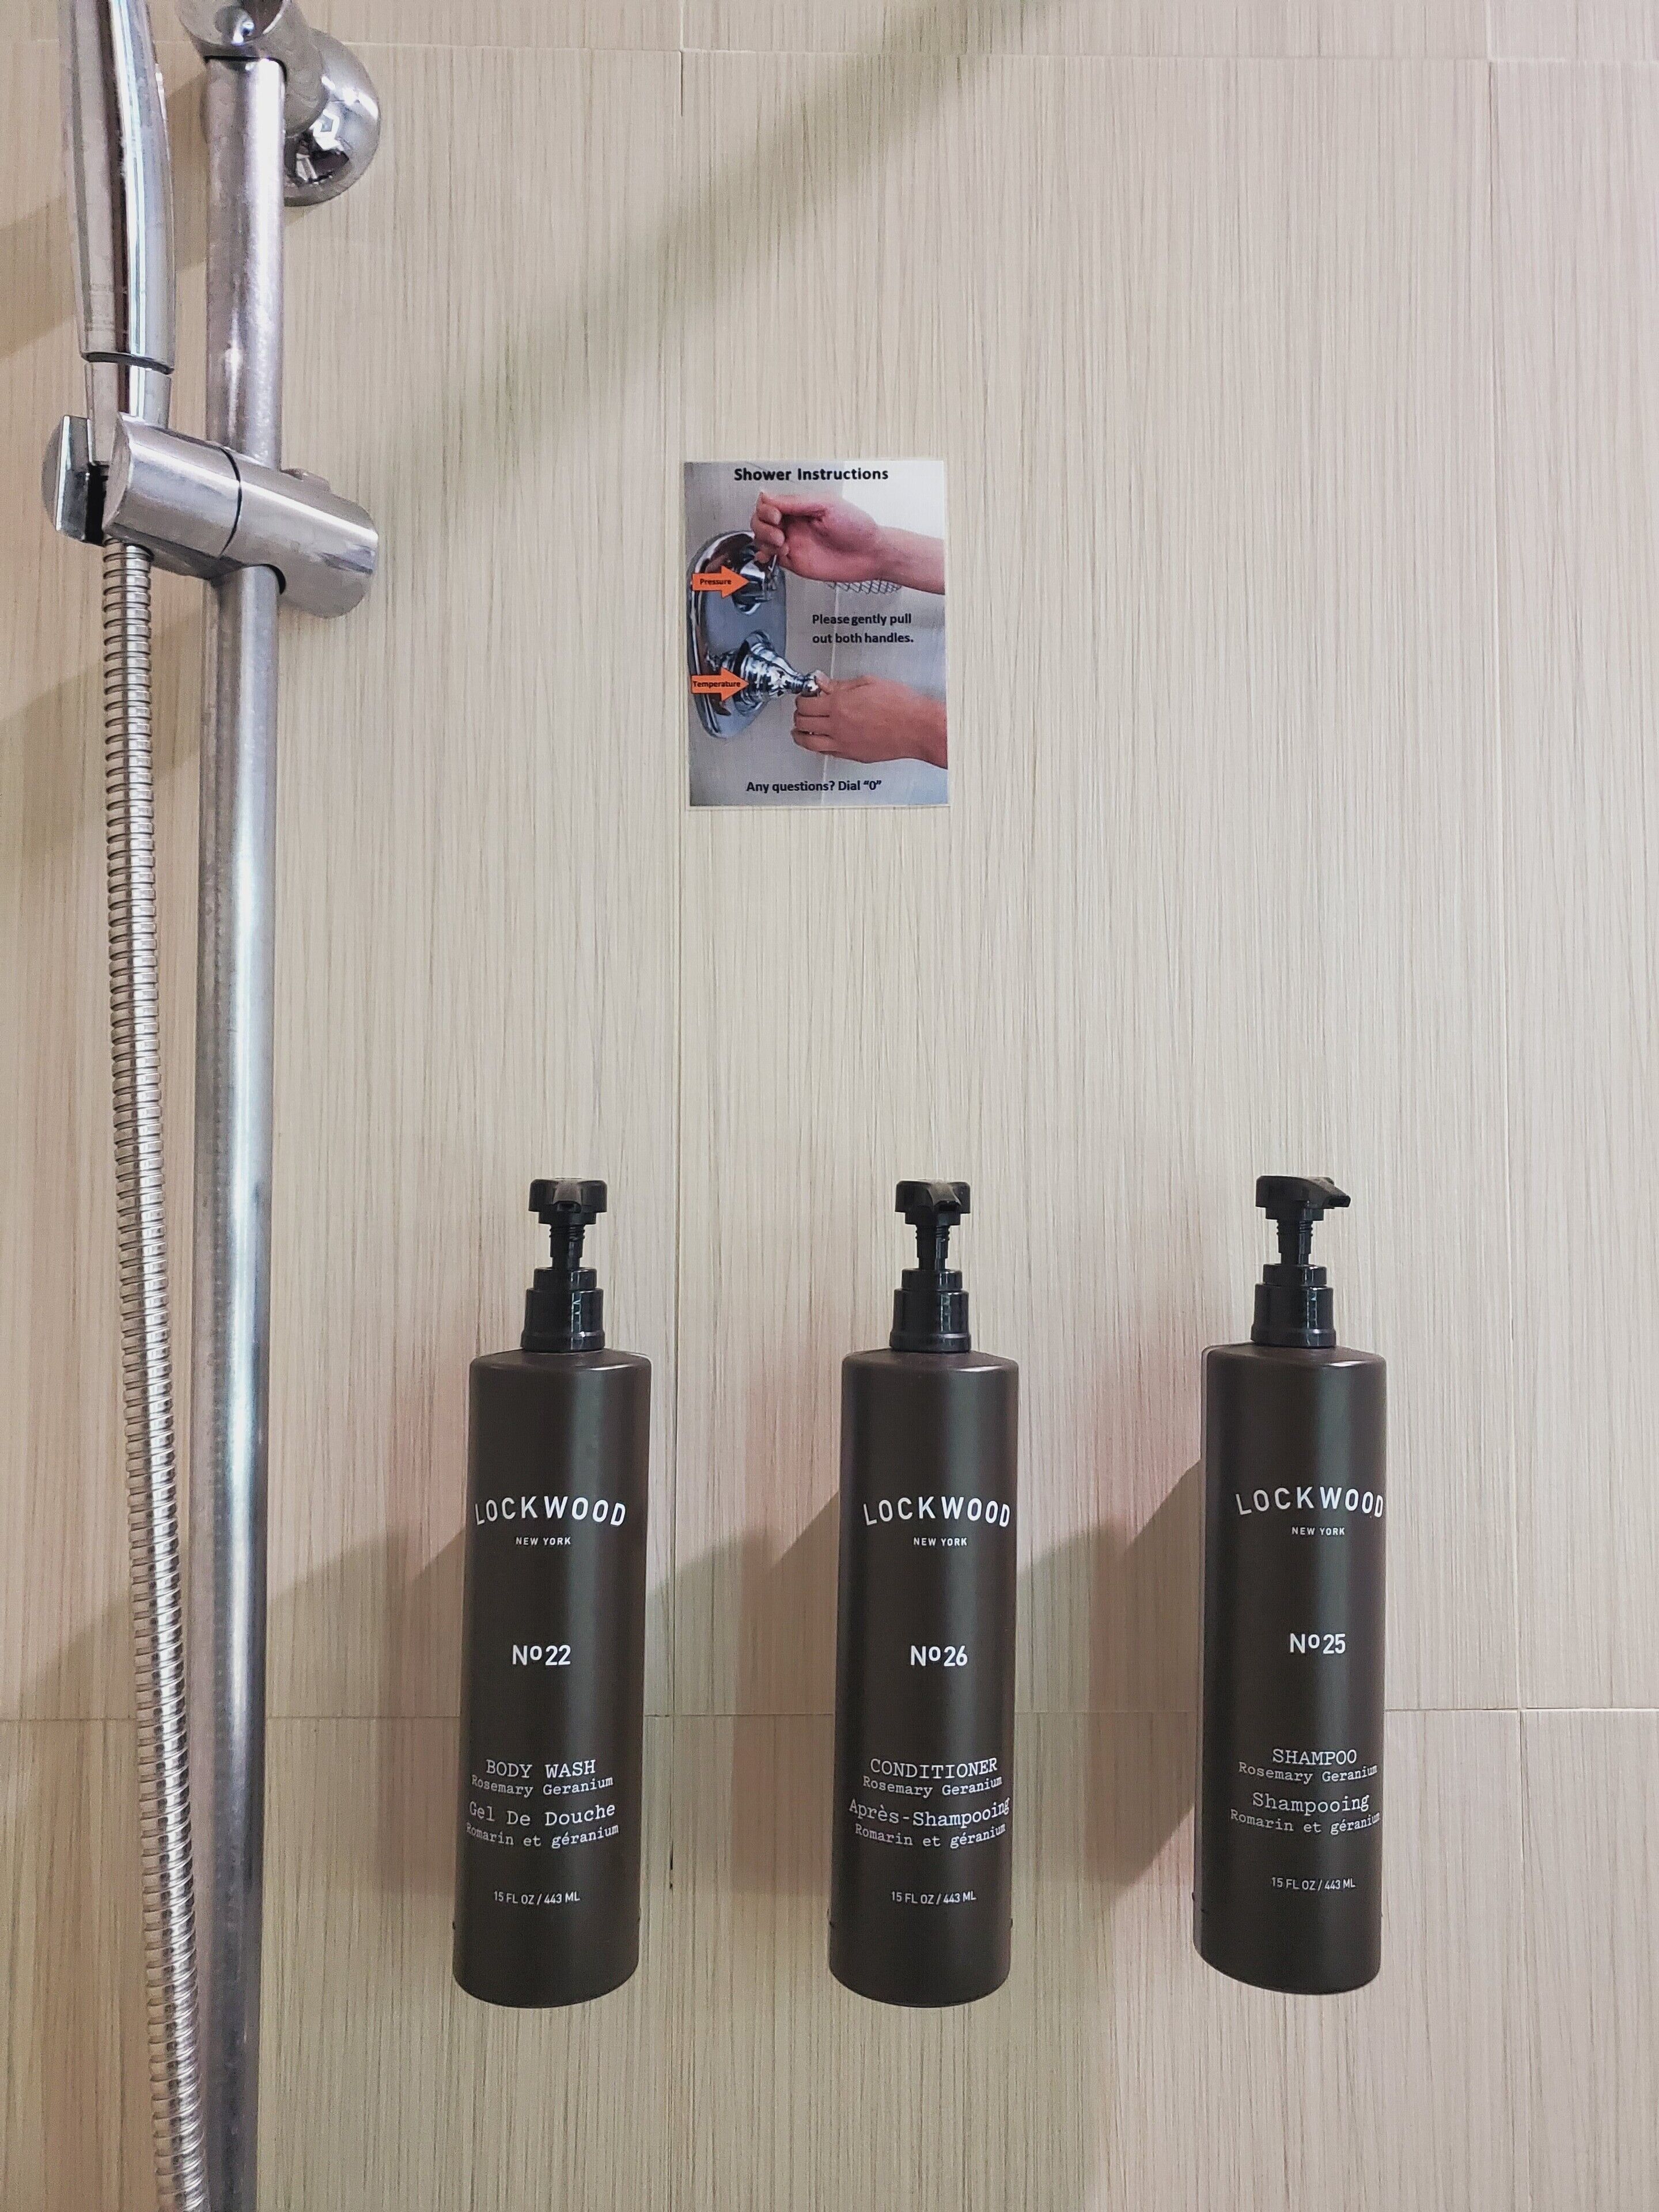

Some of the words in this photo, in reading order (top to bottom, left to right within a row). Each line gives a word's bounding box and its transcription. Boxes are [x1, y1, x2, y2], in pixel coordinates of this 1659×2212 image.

[734, 468, 791, 481] Shower
[797, 468, 889, 480] Instructions
[812, 614, 849, 624] Please
[851, 614, 887, 626] gently
[889, 613, 911, 626] pull
[812, 634, 832, 643] out
[835, 632, 862, 643] both
[865, 632, 914, 643] handles.
[693, 680, 741, 688] Temperature
[747, 781, 769, 793] Any
[772, 781, 835, 793] questions?
[838, 781, 861, 791] Dial
[475, 1496, 626, 1526] LOCKWOOD
[863, 1497, 1010, 1527] LOCKWOOD
[1236, 1487, 1383, 1517] LOCKWOOD
[543, 1537, 571, 1546] YORK
[914, 1537, 936, 1546] NEW
[941, 1537, 967, 1546] YORK
[1272, 1749, 1357, 1766] SHAMPOO
[486, 1759, 532, 1778] BODY
[545, 1760, 596, 1778] WASH
[870, 1758, 997, 1779] CONDITIONER
[1239, 1762, 1313, 1784] Rosemary
[1322, 1765, 1377, 1782] Geranium
[472, 1775, 533, 1798] Rosemary
[543, 1777, 613, 1796] Geranium
[863, 1776, 933, 1798] Rosemary
[942, 1777, 1002, 1796] Geranium
[469, 1801, 495, 1821] Gel
[507, 1810, 531, 1825] De
[545, 1804, 616, 1826] Douche
[849, 1797, 1010, 1828] Après-Shampooing
[1253, 1792, 1370, 1816] Shampooing
[1231, 1809, 1294, 1831] Romarin
[1304, 1821, 1321, 1833] et
[1331, 1812, 1380, 1835] géranium
[467, 1823, 514, 1845] Romarin
[524, 1835, 541, 1846] et
[552, 1825, 619, 1849] géranium
[855, 1824, 913, 1845] Romarin
[923, 1835, 941, 1847] et
[950, 1824, 1006, 1849] géranium
[1271, 1877, 1283, 1888] 15
[1286, 1879, 1300, 1889] FL
[1302, 1880, 1315, 1891] OZ
[1325, 1879, 1340, 1889] 443
[1343, 1878, 1355, 1888] ML
[494, 1891, 503, 1902] 15
[507, 1893, 518, 1904] FL
[521, 1895, 534, 1904] OZ
[544, 1894, 562, 1903] 443
[565, 1891, 580, 1902] ML
[892, 1891, 902, 1902] 15
[905, 1893, 918, 1903] FL
[921, 1895, 934, 1904] OZ
[944, 1893, 960, 1903] 443
[963, 1891, 976, 1901] ML
